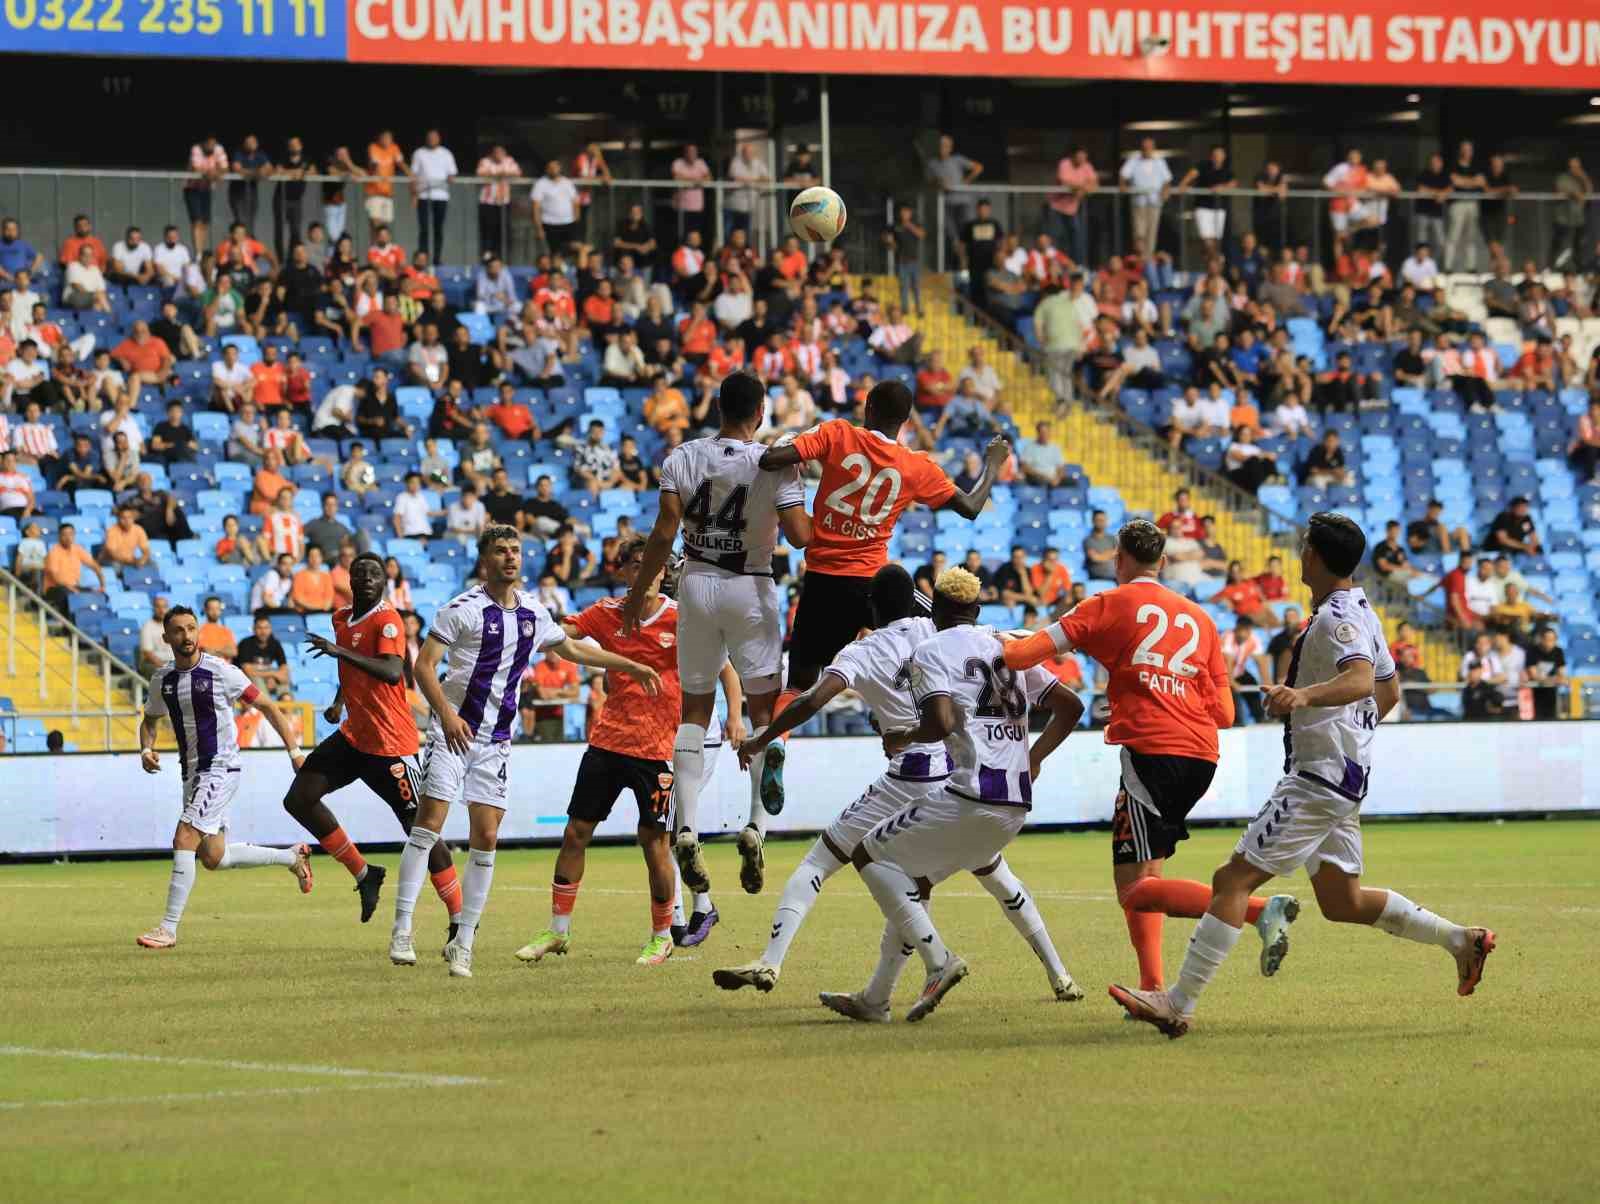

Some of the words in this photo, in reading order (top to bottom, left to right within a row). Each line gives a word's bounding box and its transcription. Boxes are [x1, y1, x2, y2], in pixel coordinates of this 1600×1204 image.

[5, 0, 124, 30] 0322
[138, 0, 223, 35] 235
[237, 0, 273, 36] 11
[288, 0, 326, 37] 11
[354, 0, 989, 61] CUMHURBAŞKANIMIZA
[1002, 7, 1073, 55] BU
[1088, 8, 1373, 74] MUHTEŞEM
[684, 478, 750, 530] 44
[824, 453, 902, 526] 20
[1131, 603, 1200, 678] 22
[962, 656, 1027, 719] 28
[398, 778, 412, 801] 8
[497, 761, 508, 785] 4
